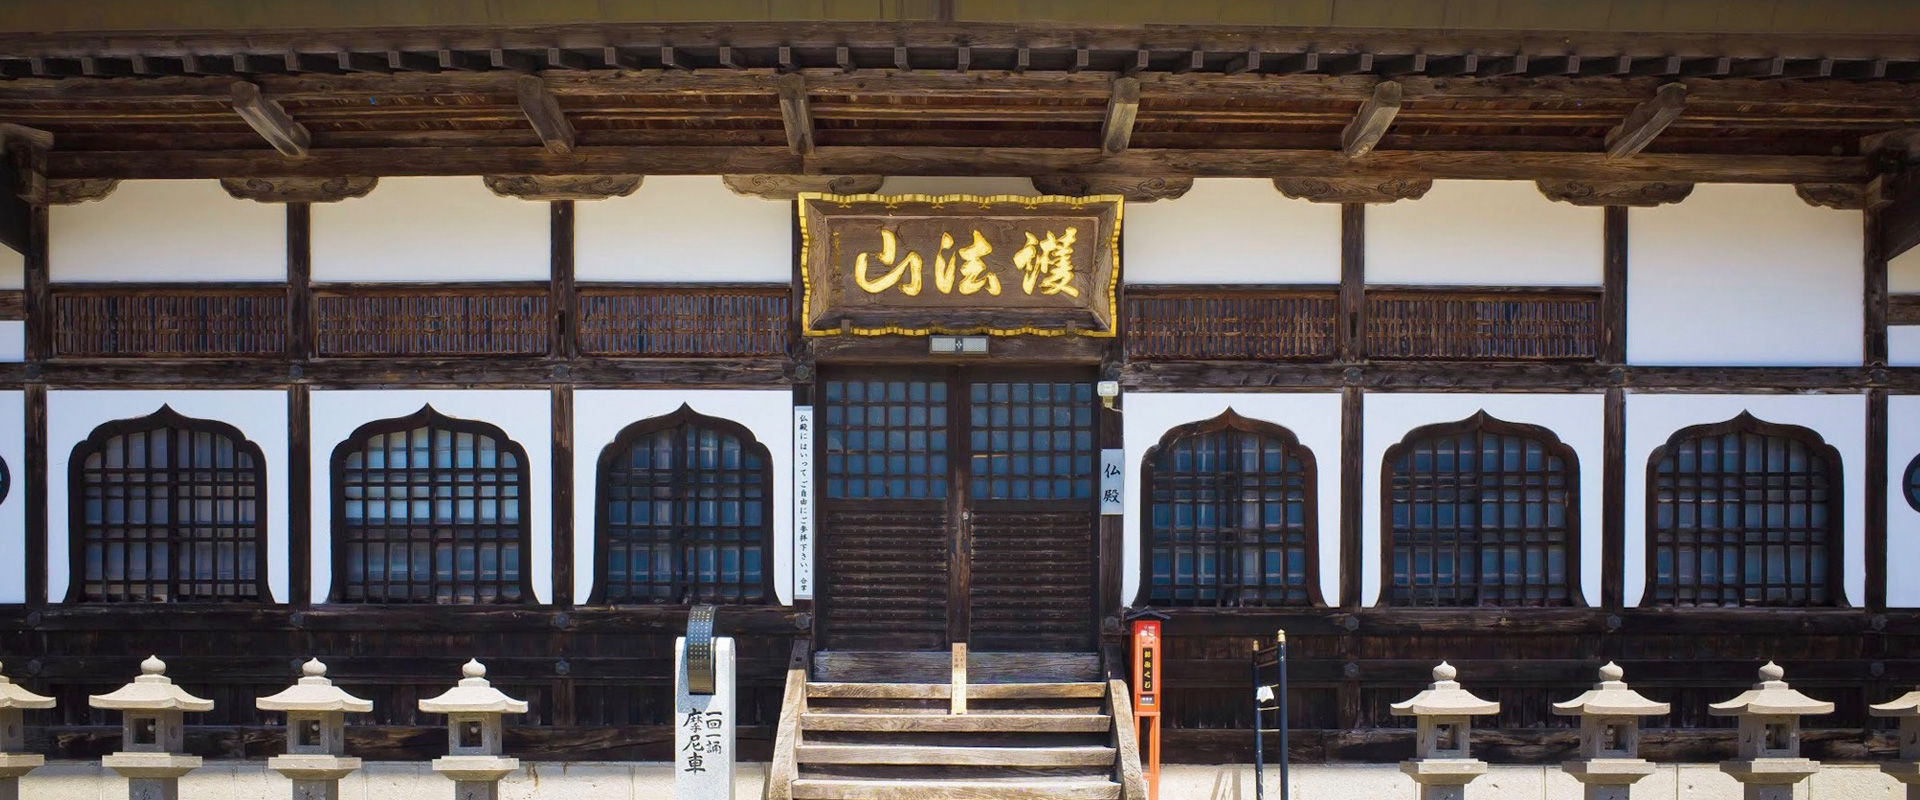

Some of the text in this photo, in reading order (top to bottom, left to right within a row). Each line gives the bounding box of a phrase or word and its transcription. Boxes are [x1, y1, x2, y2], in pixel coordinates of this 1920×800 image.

[854, 226, 1080, 297] 護法山
[1103, 463, 1121, 503] 仏殿
[682, 708, 706, 774] 摩尼車
